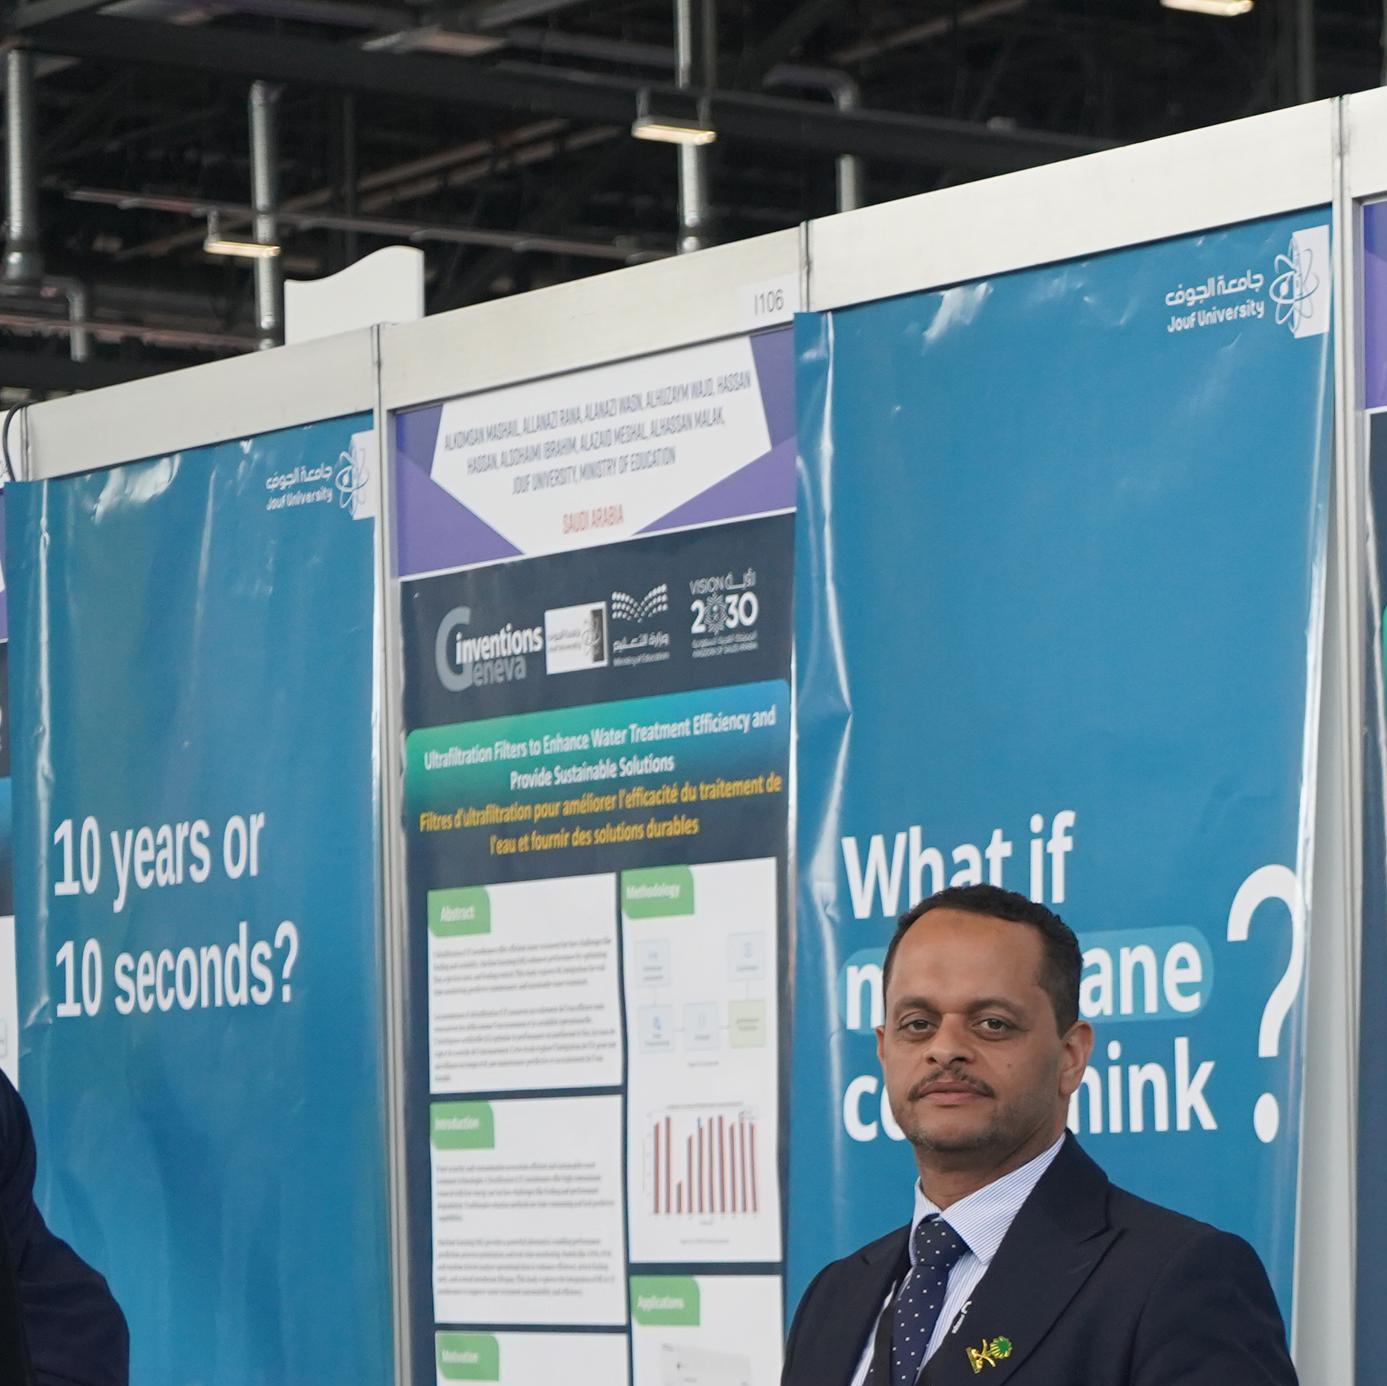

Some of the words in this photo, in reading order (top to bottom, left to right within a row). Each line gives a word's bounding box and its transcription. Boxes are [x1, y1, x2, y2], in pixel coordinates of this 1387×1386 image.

[754, 289, 784, 316] I106
[423, 743, 493, 771] Ultrafiltration
[494, 739, 528, 761] Filters
[528, 738, 542, 757] to
[542, 732, 590, 755] Enhance
[590, 727, 628, 748] Water
[628, 718, 691, 744] Treatment
[692, 711, 751, 736] Efficiency
[751, 703, 777, 728] and
[510, 768, 552, 791] Provide
[553, 758, 618, 783] Sustainable
[619, 755, 674, 778] Solutions
[53, 815, 101, 897] 10
[110, 819, 211, 914] years
[223, 812, 265, 880] or
[842, 825, 1013, 918] What
[1029, 809, 1076, 904] if
[55, 937, 103, 1018] 10
[114, 920, 299, 1015] seconds?
